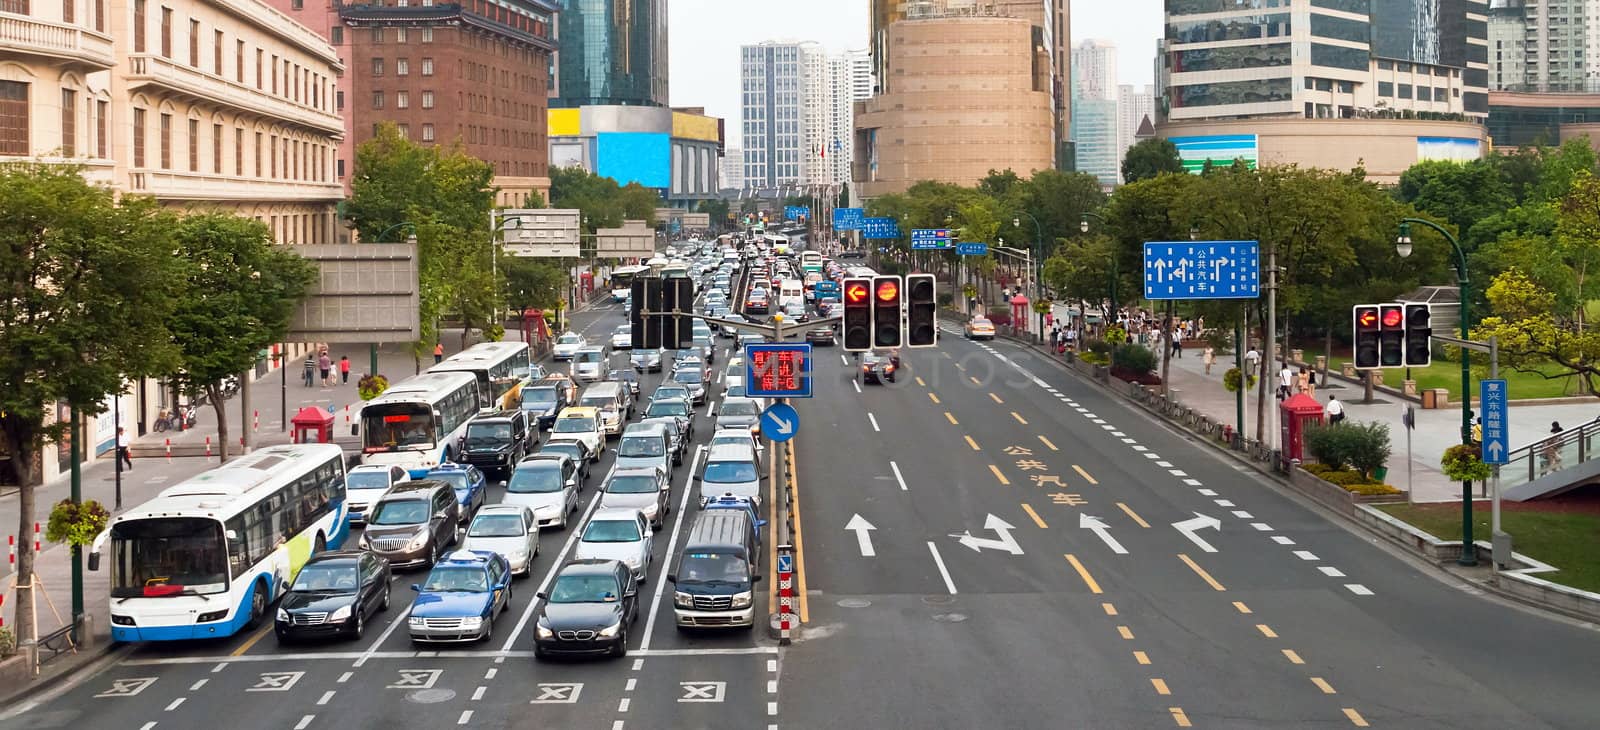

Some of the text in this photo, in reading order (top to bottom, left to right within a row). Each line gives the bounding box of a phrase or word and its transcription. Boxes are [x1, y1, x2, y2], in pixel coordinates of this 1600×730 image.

[1197, 249, 1207, 291] 公共汽车
[1487, 383, 1502, 438] 复兴东路隧道
